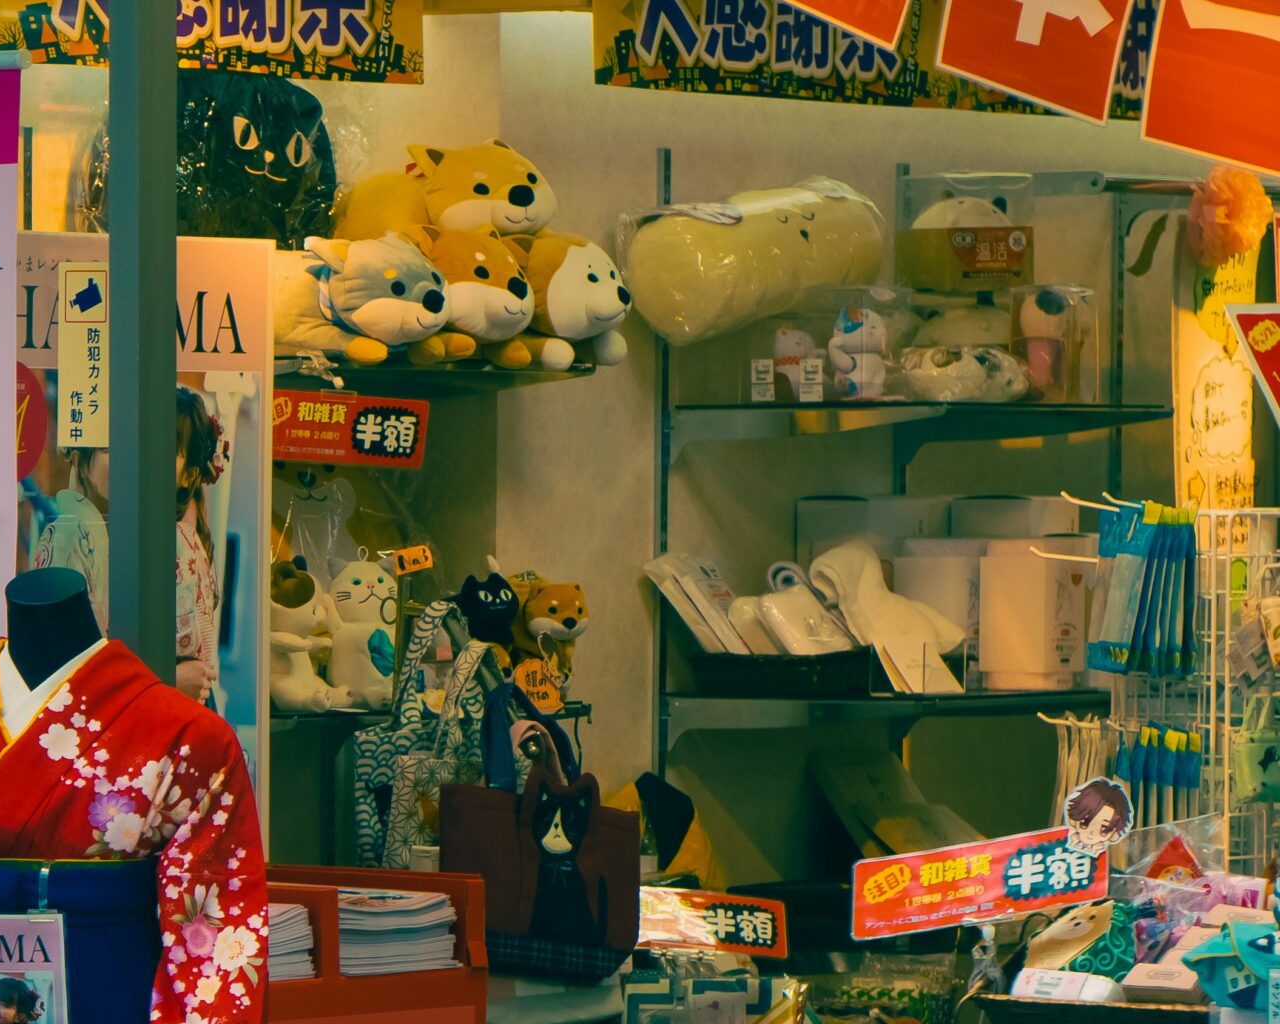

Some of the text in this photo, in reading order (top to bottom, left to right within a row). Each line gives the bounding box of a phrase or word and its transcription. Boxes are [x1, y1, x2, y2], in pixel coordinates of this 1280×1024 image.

[86, 327, 101, 416] 防犯カメラ
[69, 390, 84, 442] 作動中
[297, 401, 348, 425] 和雑貨
[355, 413, 418, 454] 半額
[866, 866, 907, 901] 注目!
[919, 852, 993, 888] 和雑貨
[1006, 846, 1092, 895] 半額
[702, 908, 773, 945] 半額
